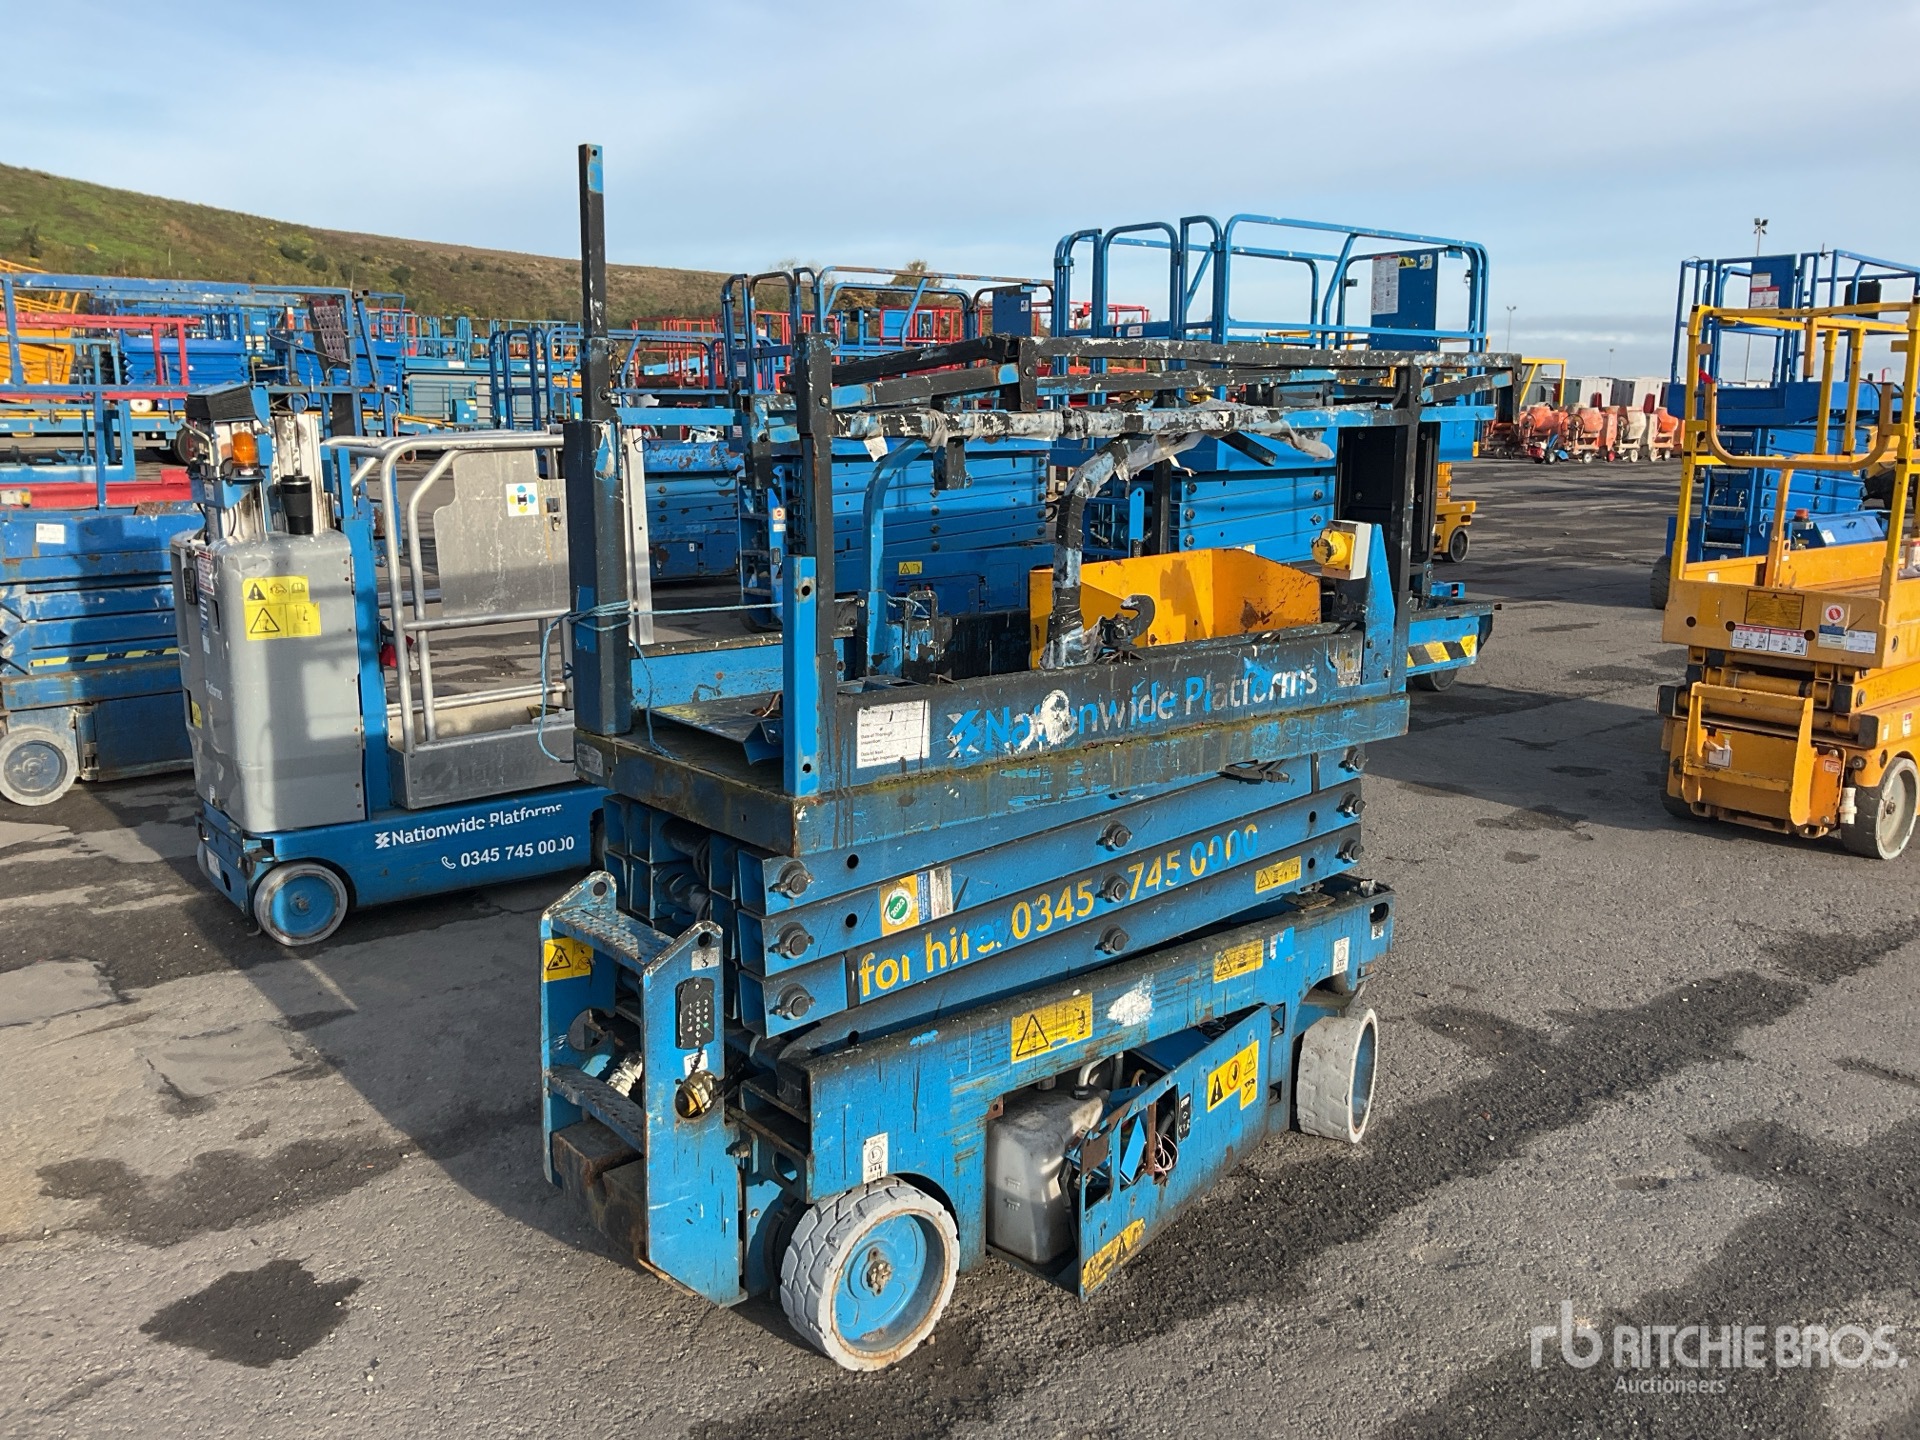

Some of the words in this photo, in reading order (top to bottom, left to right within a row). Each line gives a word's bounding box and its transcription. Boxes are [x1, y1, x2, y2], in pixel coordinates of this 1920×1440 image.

[1185, 658, 1318, 716] Platforms
[392, 815, 486, 847] Nationwide
[460, 847, 500, 868] 0345
[505, 842, 534, 861] 745
[858, 951, 915, 997] for
[1011, 878, 1095, 940] 0345
[1127, 849, 1182, 901] 745
[1189, 823, 1259, 877] 0000
[890, 898, 906, 918] 2023
